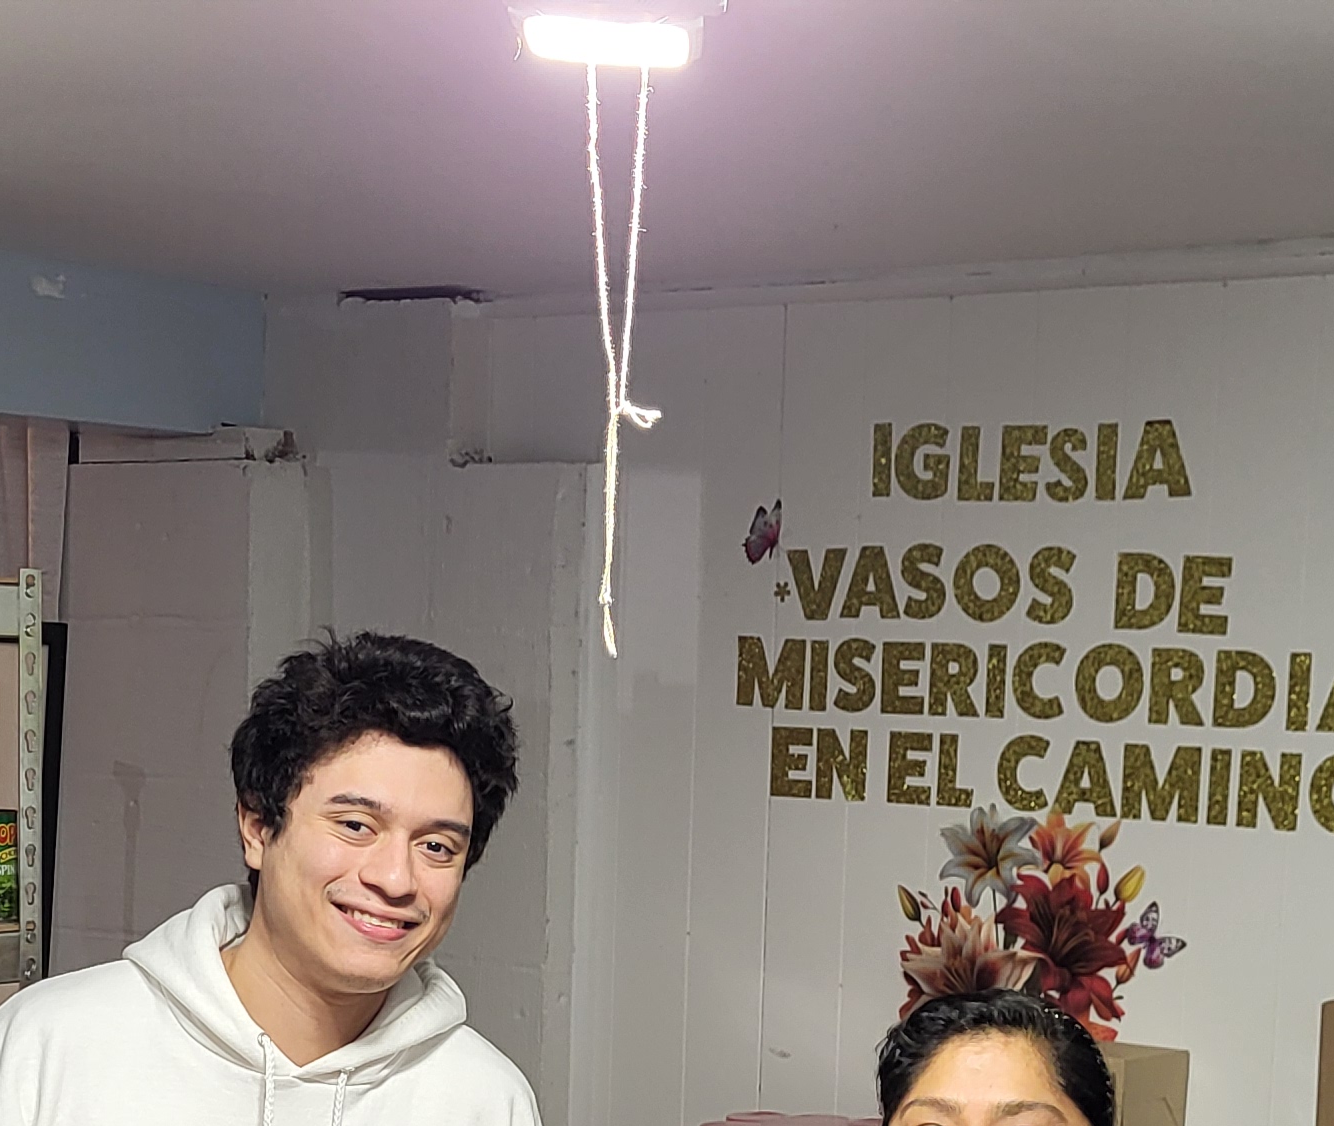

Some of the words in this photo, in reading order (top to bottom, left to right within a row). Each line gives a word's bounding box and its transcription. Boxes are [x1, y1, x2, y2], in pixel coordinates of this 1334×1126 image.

[871, 418, 1192, 503] IGLESIA
[787, 541, 1077, 625] VASOS
[1113, 551, 1234, 637] DE
[770, 726, 869, 802] EN
[885, 730, 973, 809] EL
